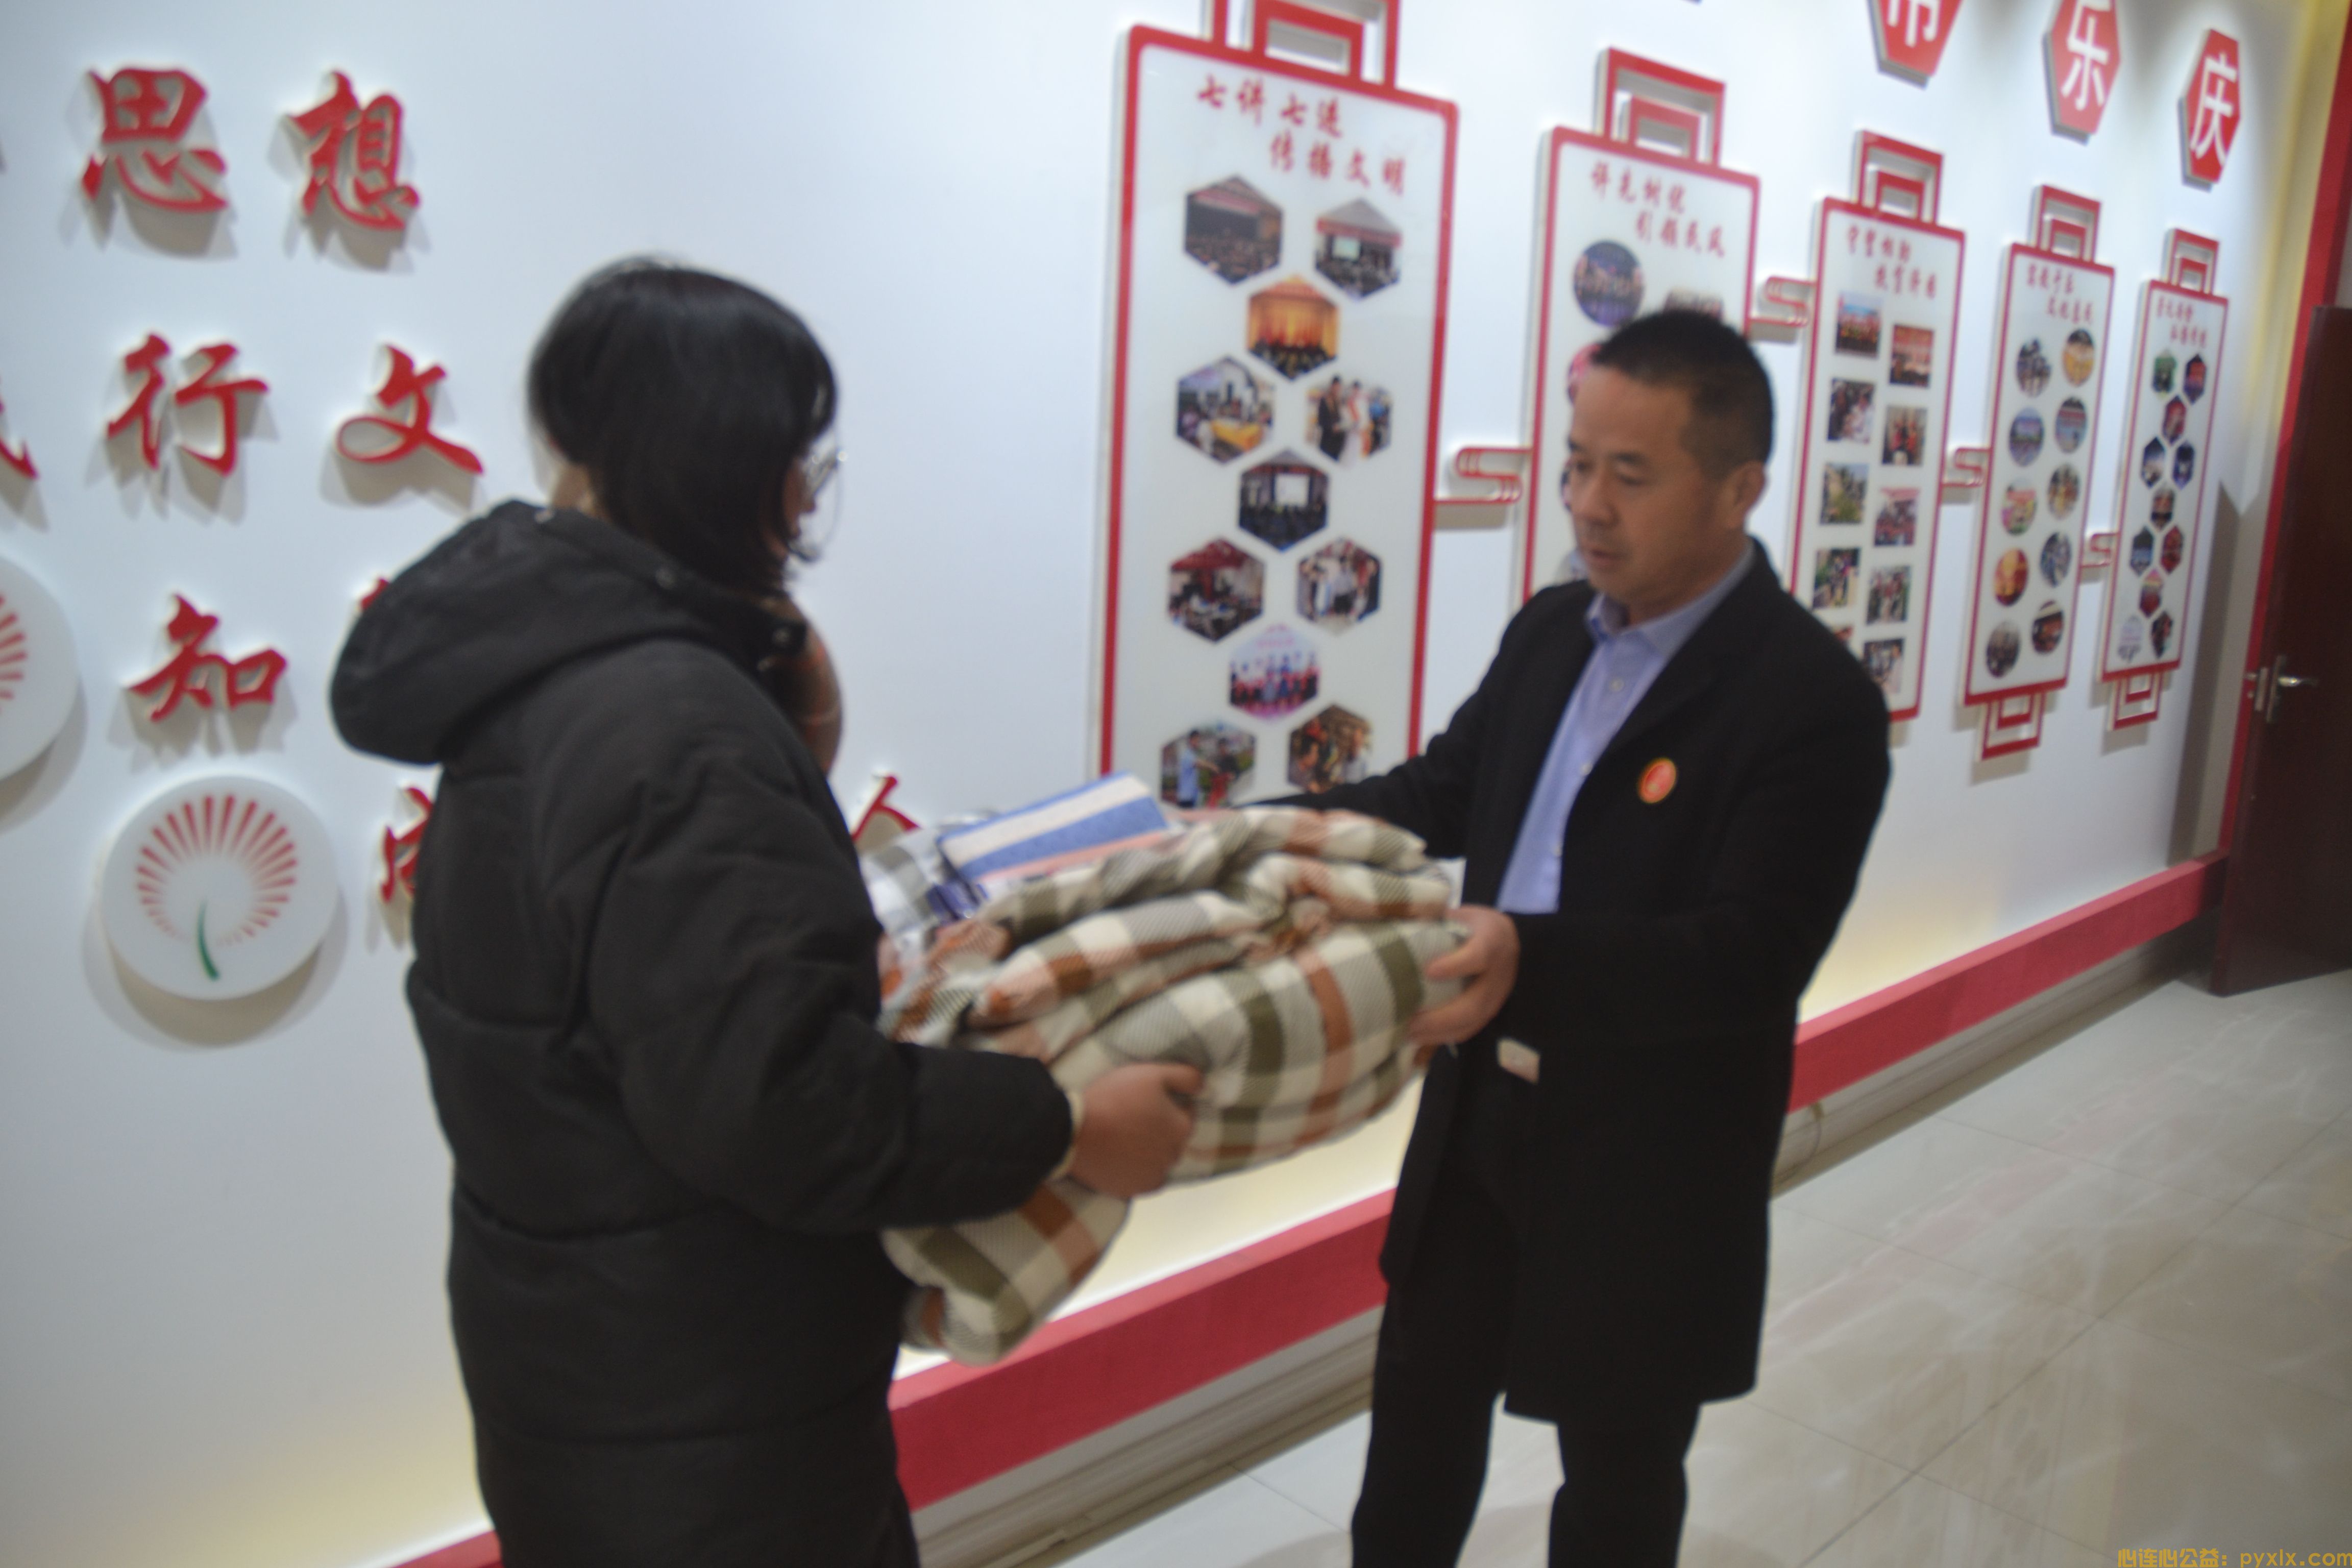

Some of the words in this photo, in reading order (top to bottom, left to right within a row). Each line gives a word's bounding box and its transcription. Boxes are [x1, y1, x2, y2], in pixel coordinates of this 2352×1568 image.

[2060, 0, 2111, 111] 乐
[2190, 53, 2238, 166] 庆
[82, 68, 420, 230] 思想
[0, 335, 483, 478] 行文
